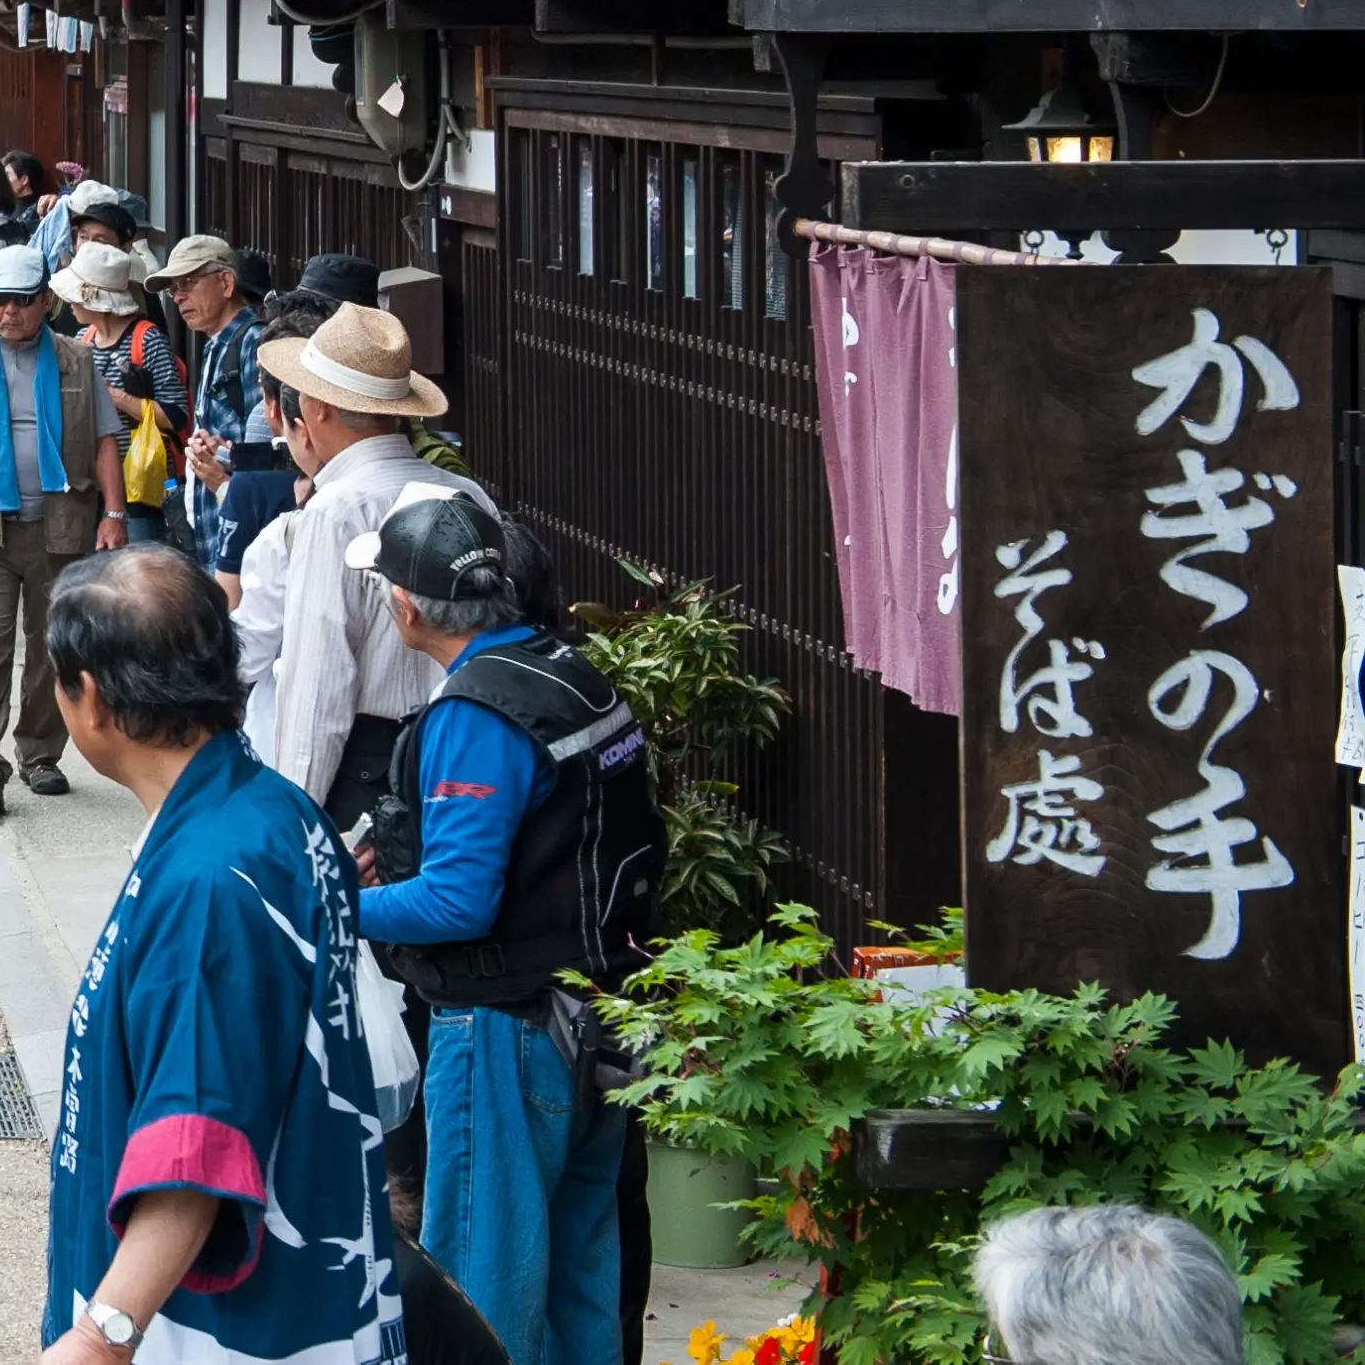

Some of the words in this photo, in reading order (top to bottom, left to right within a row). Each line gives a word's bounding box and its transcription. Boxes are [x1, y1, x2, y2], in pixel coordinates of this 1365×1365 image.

[986, 530, 1107, 877] そば處
[1131, 309, 1300, 960] かぎの手
